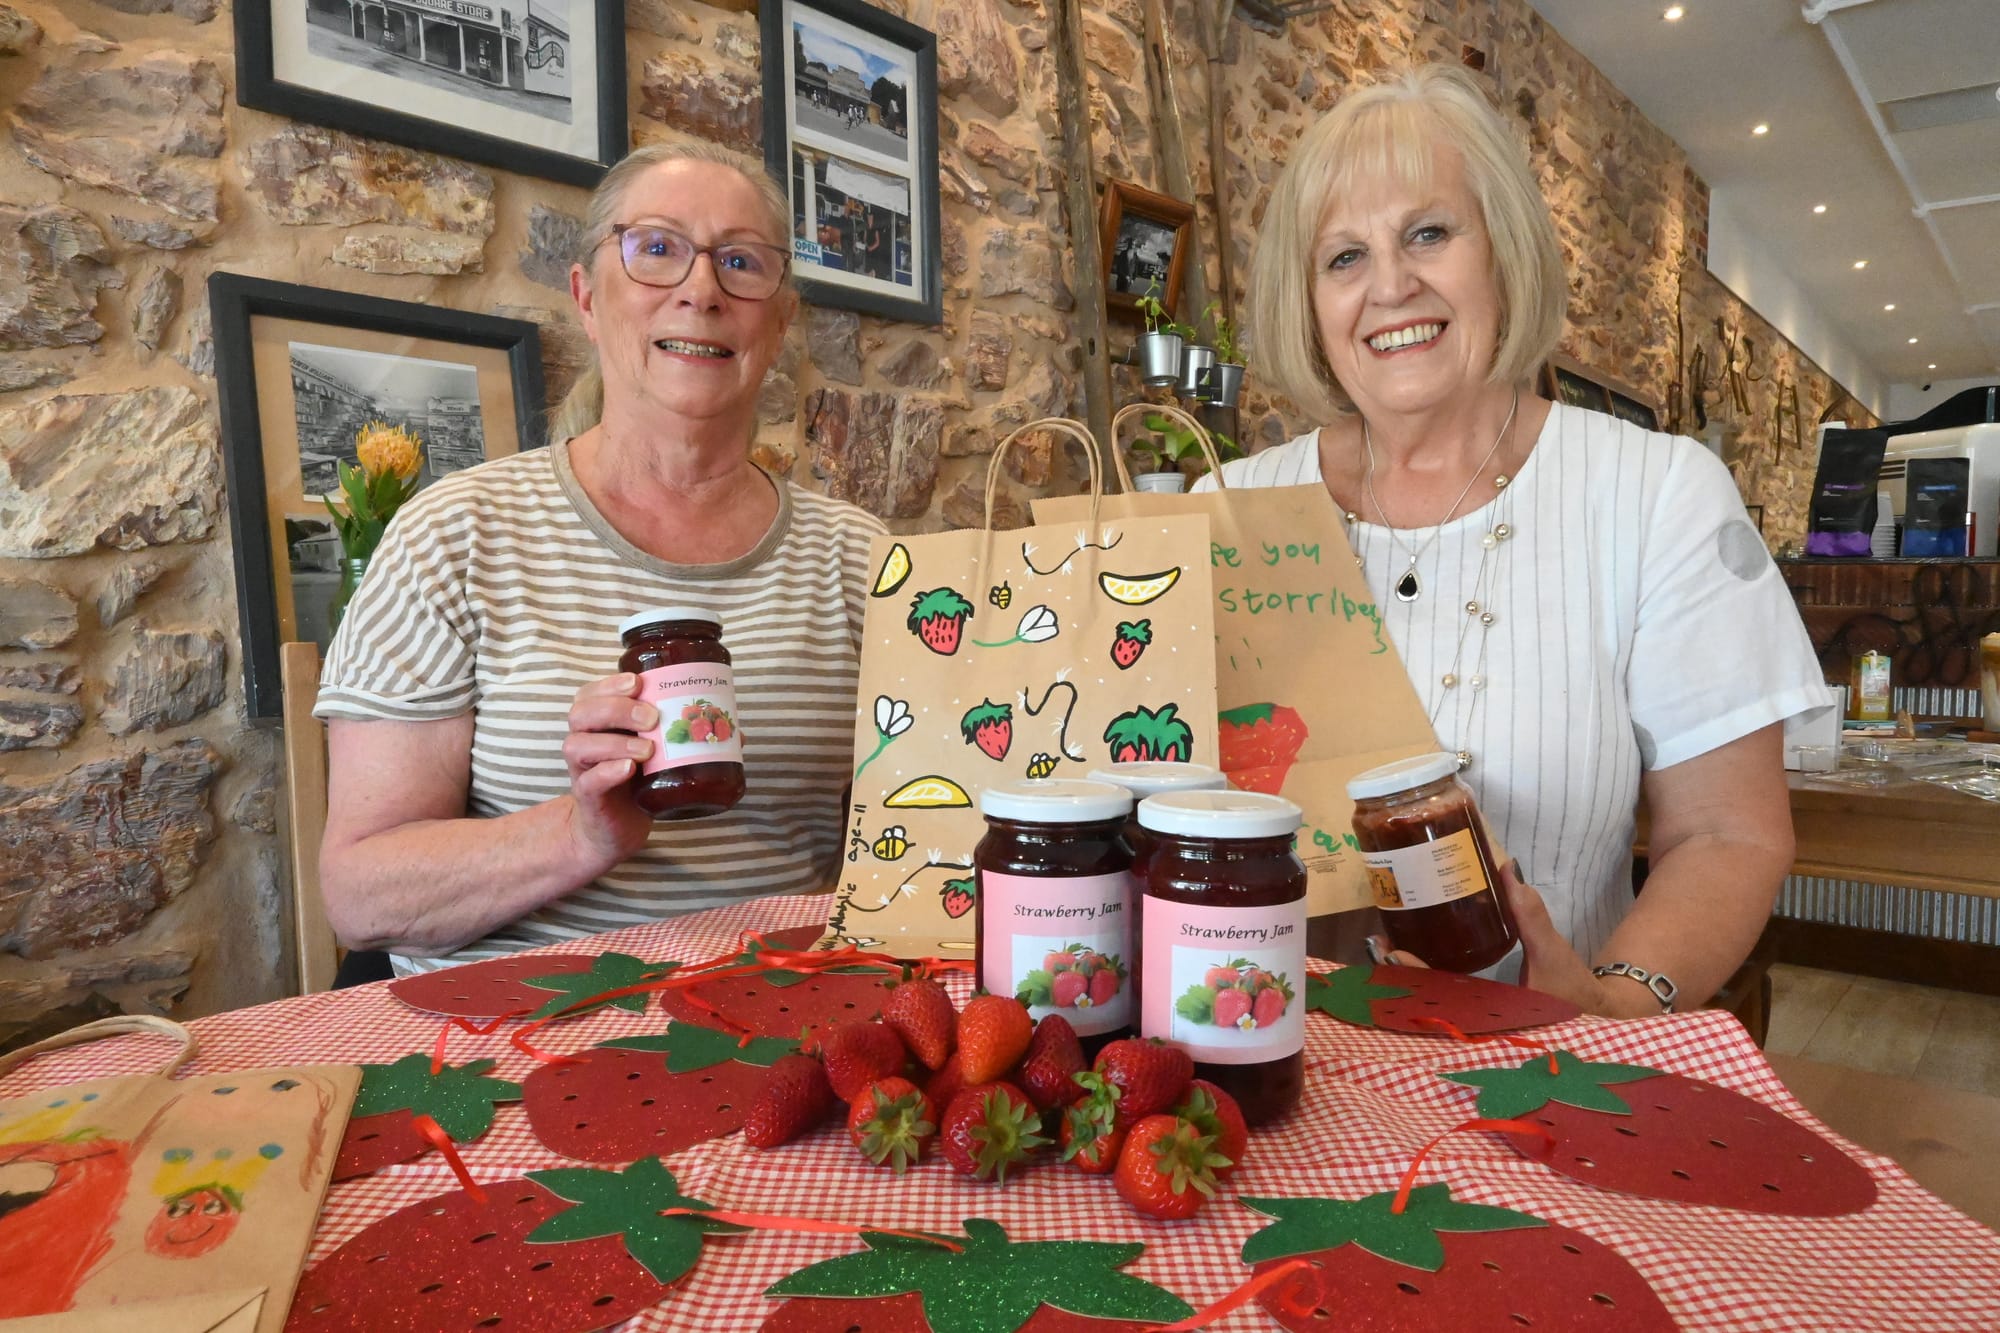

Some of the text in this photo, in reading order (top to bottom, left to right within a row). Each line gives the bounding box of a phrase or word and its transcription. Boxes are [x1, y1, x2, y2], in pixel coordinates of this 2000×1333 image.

[456, 2, 489, 19] STORE
[795, 240, 818, 255] OPEN
[1261, 541, 1320, 567] you
[658, 676, 713, 690] Strawberry
[1013, 901, 1123, 921] Strawberry Jam
[1179, 922, 1294, 943] Strawberry Jam
